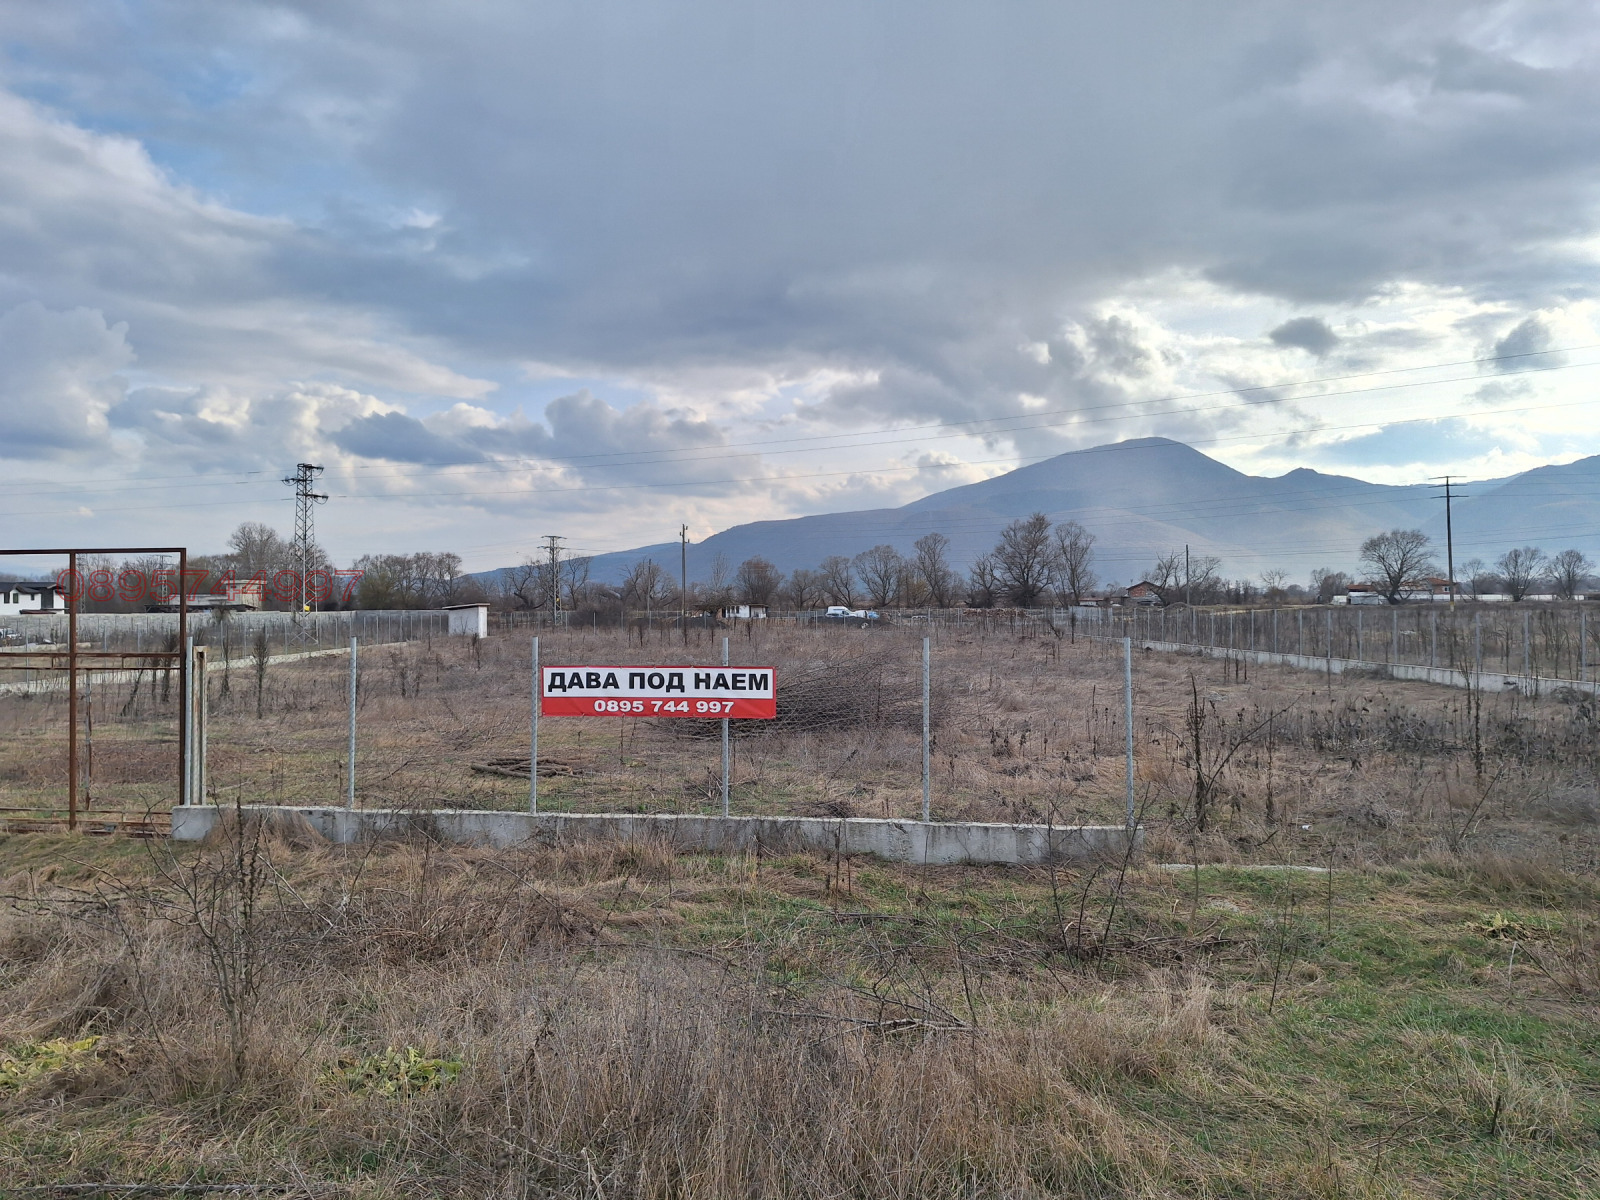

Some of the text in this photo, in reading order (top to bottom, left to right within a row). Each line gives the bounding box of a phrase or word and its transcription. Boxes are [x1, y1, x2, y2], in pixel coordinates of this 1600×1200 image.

[547, 672, 769, 693] ДАВА ПОД НАЕМ
[594, 700, 734, 713] 0895 744 997
